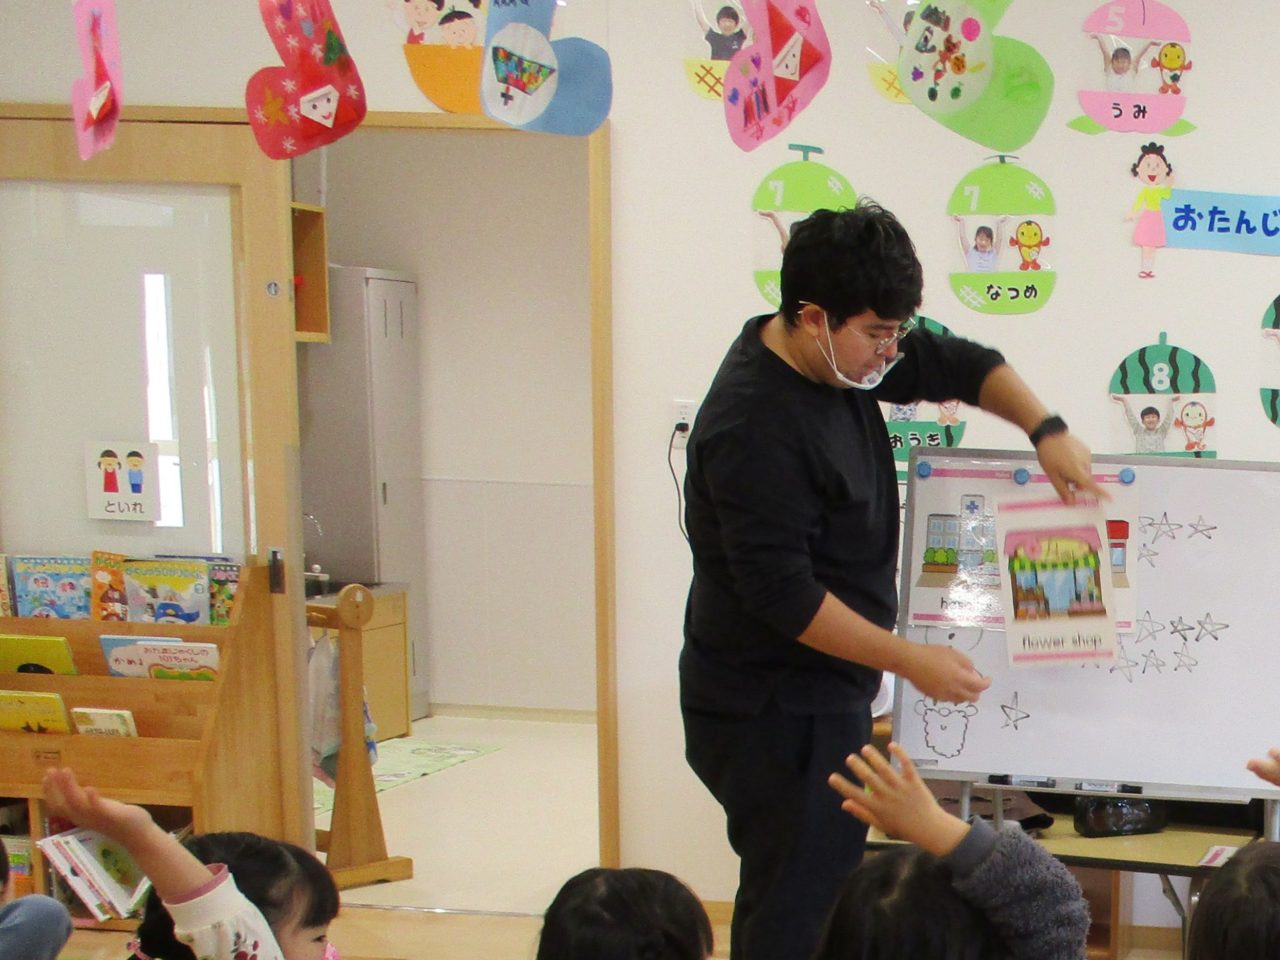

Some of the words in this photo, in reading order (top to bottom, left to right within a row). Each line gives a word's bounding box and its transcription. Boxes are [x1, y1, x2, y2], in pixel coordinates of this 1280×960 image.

[1105, 6, 1124, 31] 5
[1112, 103, 1147, 119] うみ
[768, 180, 784, 206] 7
[963, 186, 980, 211] 7
[986, 284, 1037, 300] なつめ
[1151, 362, 1171, 391] 8
[104, 501, 145, 515] といれ
[1022, 633, 1065, 650] flower
